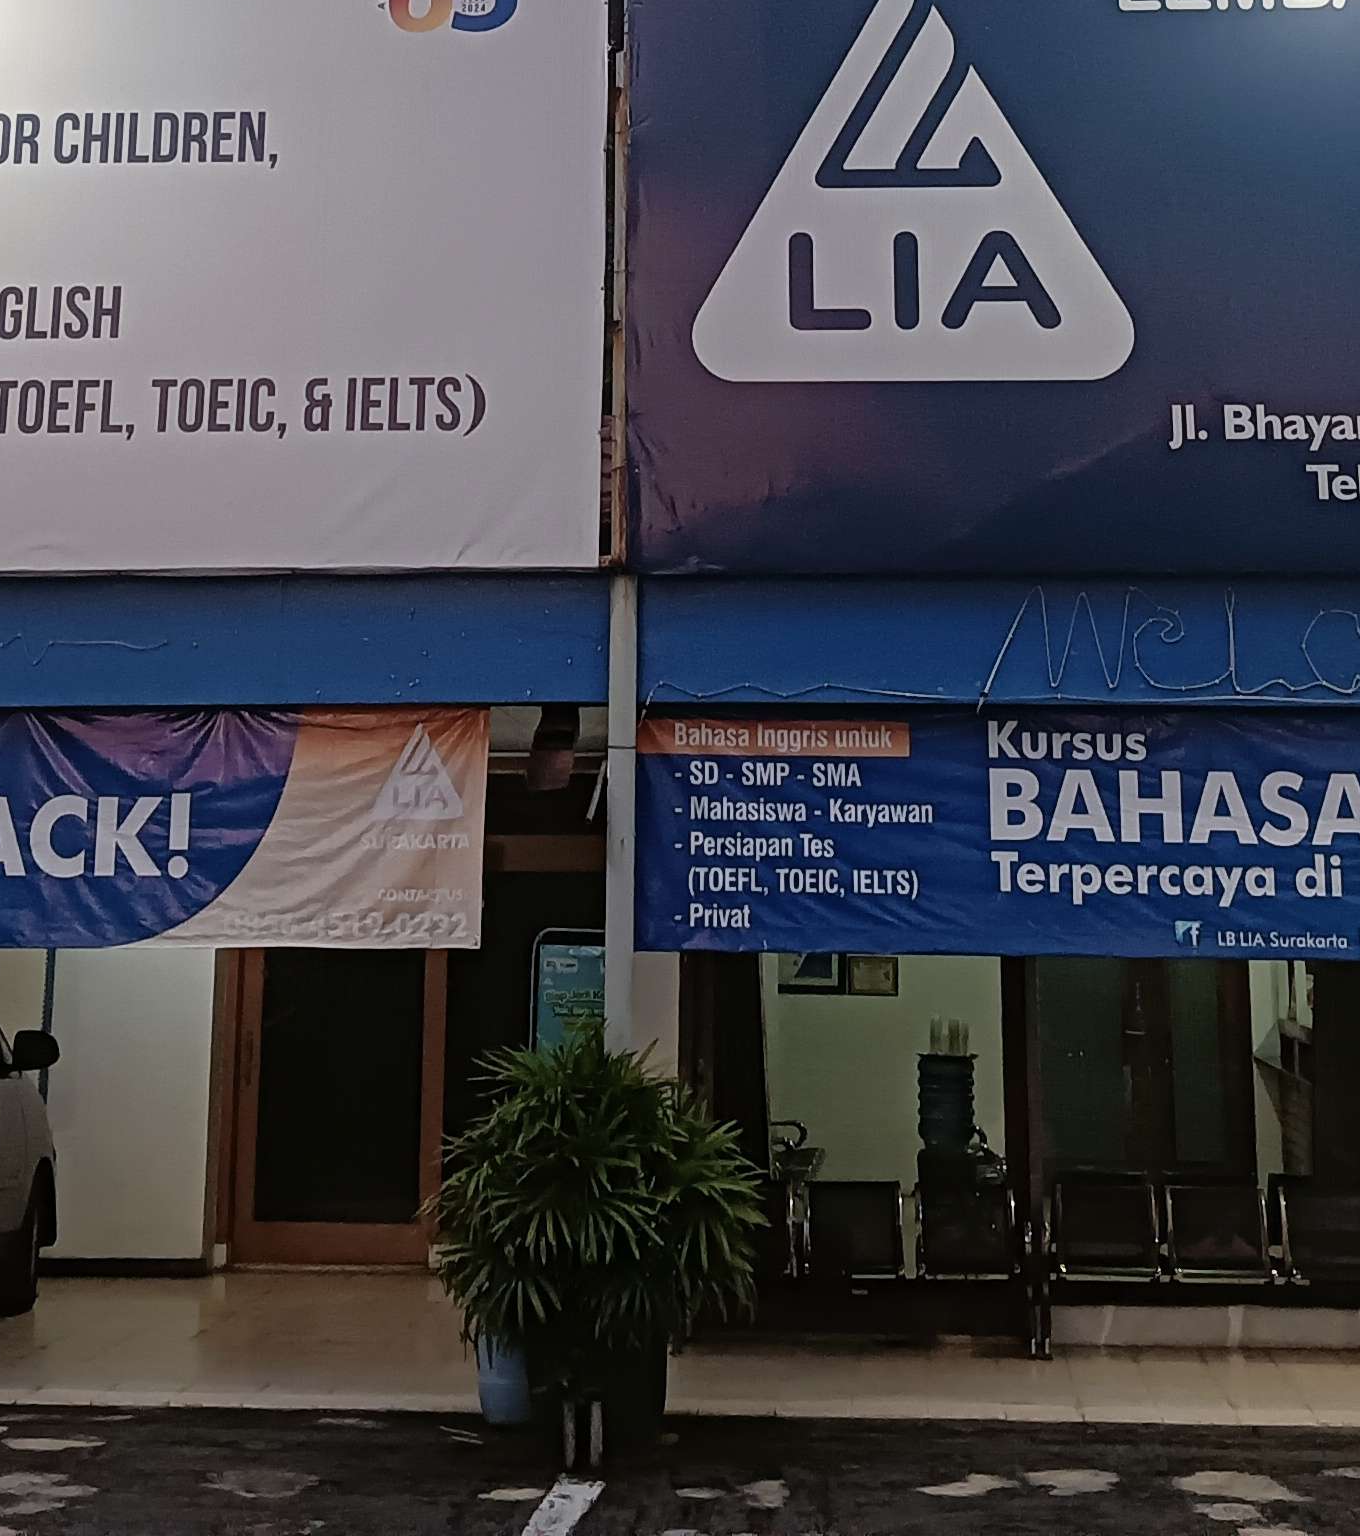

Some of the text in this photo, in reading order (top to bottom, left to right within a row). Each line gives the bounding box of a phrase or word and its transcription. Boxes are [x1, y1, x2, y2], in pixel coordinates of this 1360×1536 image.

[461, 3, 487, 13] 2024
[54, 111, 280, 170] CHILDREN,
[788, 230, 1062, 331] LIA
[151, 377, 287, 439] TOEIC,
[303, 377, 333, 432] &
[344, 373, 487, 438] IELTS)
[1169, 403, 1209, 449] Jl.
[674, 722, 893, 753] Bahasa Inggris untuk
[986, 720, 1148, 761] Kursus
[688, 761, 719, 786] SD
[741, 761, 790, 787] SMP
[811, 762, 862, 788] SMA
[392, 784, 449, 810] LIA
[689, 796, 807, 823] Mahasiswa
[828, 798, 934, 829] Karyawan
[689, 831, 794, 861] Persiapan
[800, 833, 835, 859] Tes
[688, 867, 920, 901] (TOEFL, TOEIC, IELTS)
[989, 850, 1277, 908] Terpercaya
[1294, 854, 1343, 900] di
[689, 903, 751, 929] Privat
[1216, 931, 1236, 948] LB
[1238, 931, 1265, 948] LIA
[1269, 931, 1348, 950] Surakarta
